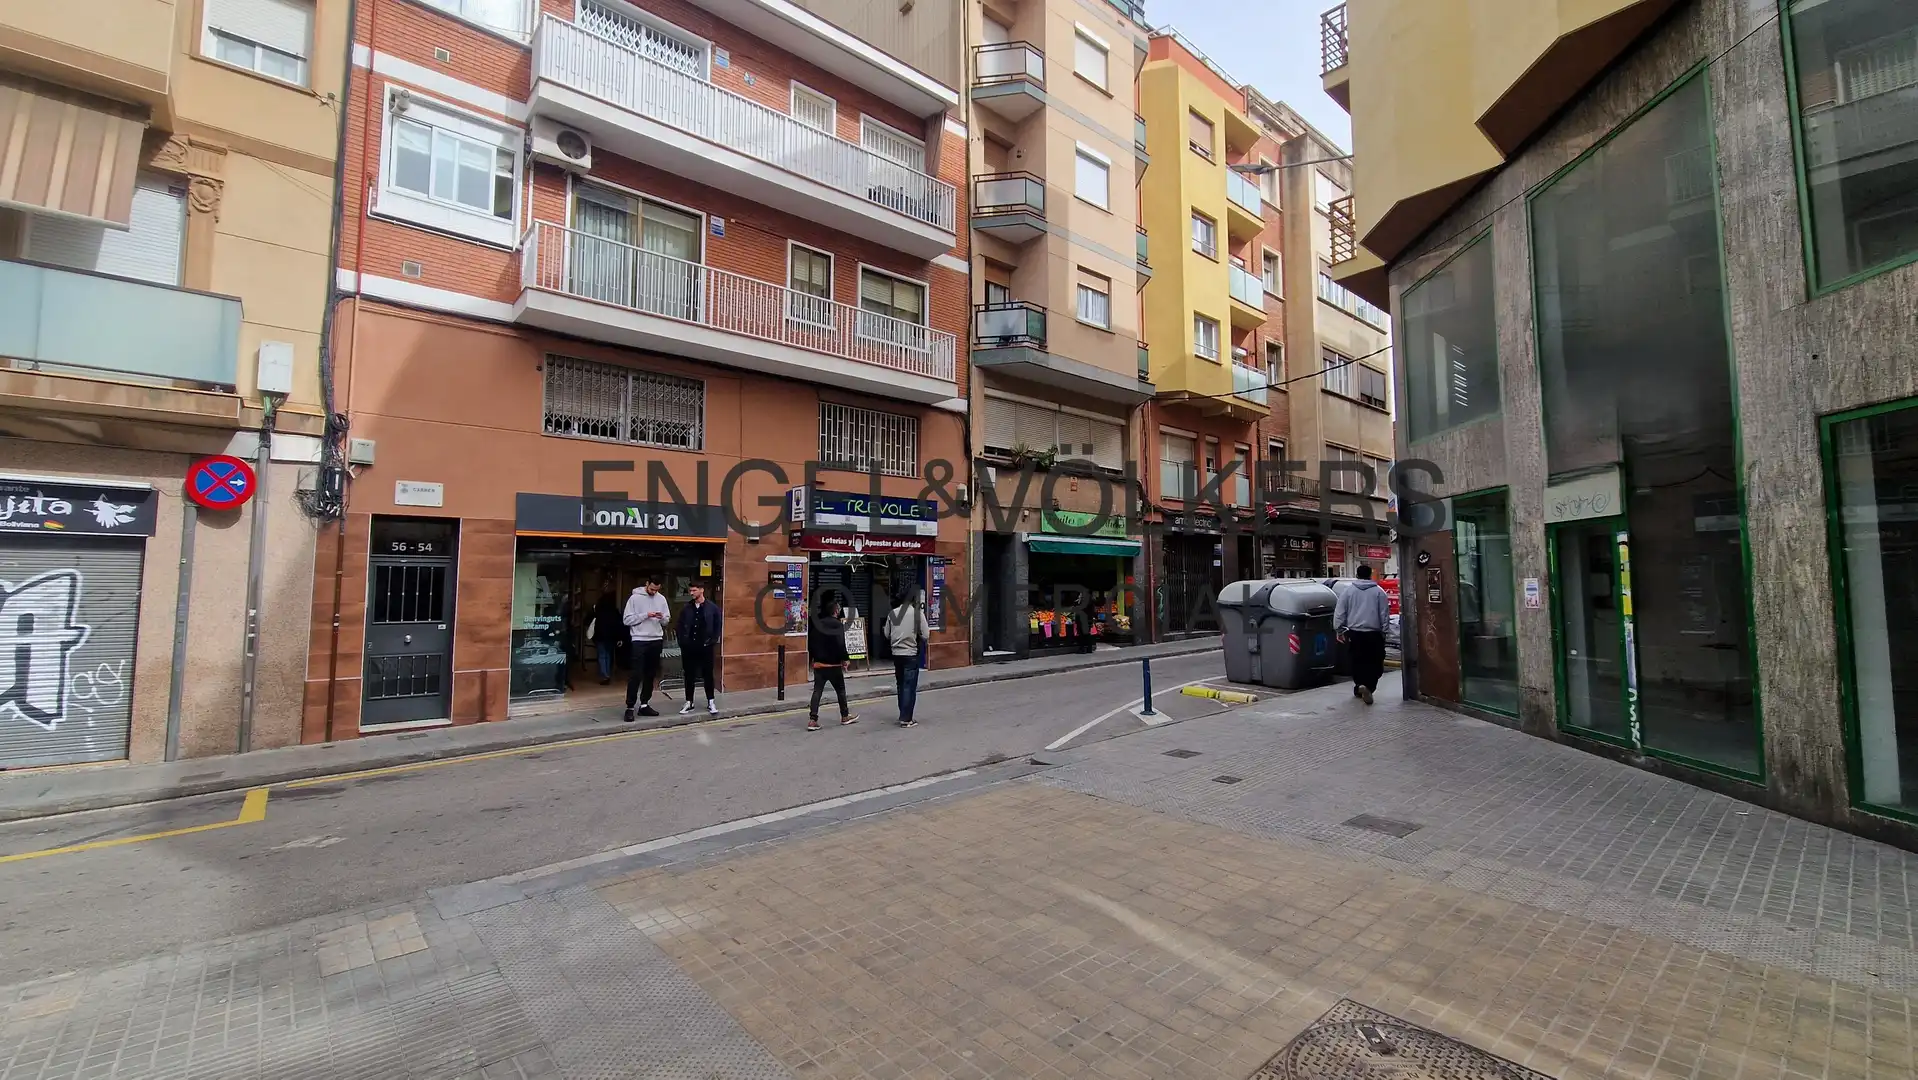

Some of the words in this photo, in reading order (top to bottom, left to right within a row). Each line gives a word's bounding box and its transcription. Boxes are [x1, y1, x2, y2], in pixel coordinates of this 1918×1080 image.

[813, 496, 834, 510] EL
[842, 498, 933, 518] TREVOLET
[580, 504, 679, 530] bonArea
[392, 542, 407, 551] 56
[418, 543, 433, 552] 54
[865, 539, 891, 547] Apuestas
[524, 615, 562, 623] Benvinguts
